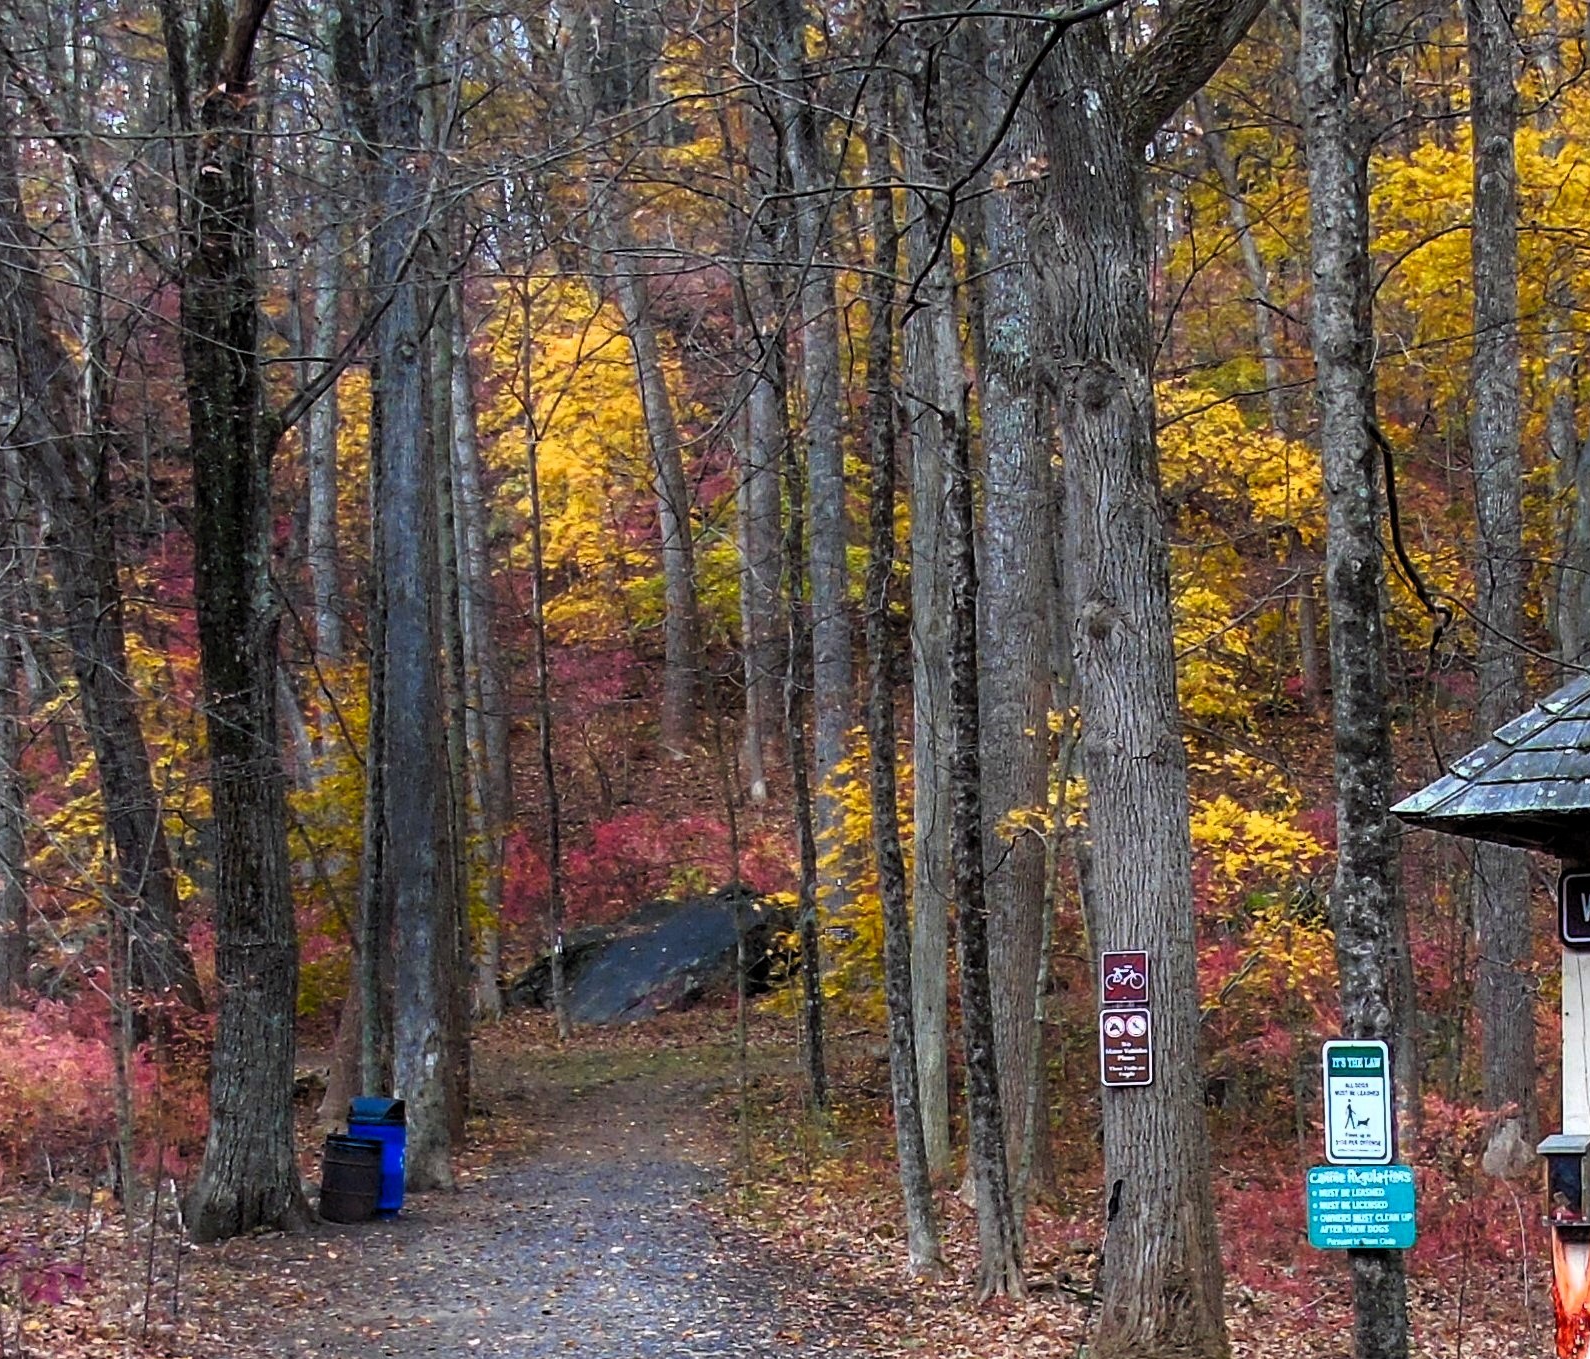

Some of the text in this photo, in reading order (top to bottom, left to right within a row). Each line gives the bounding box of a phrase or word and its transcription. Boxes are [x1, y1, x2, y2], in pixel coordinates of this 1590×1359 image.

[1347, 1057, 1363, 1069] THE
[1347, 1168, 1412, 1186] Regulations
[1375, 1213, 1400, 1222] CLEAN
[1400, 1212, 1413, 1222] UP
[1367, 1224, 1390, 1234] DOGS
